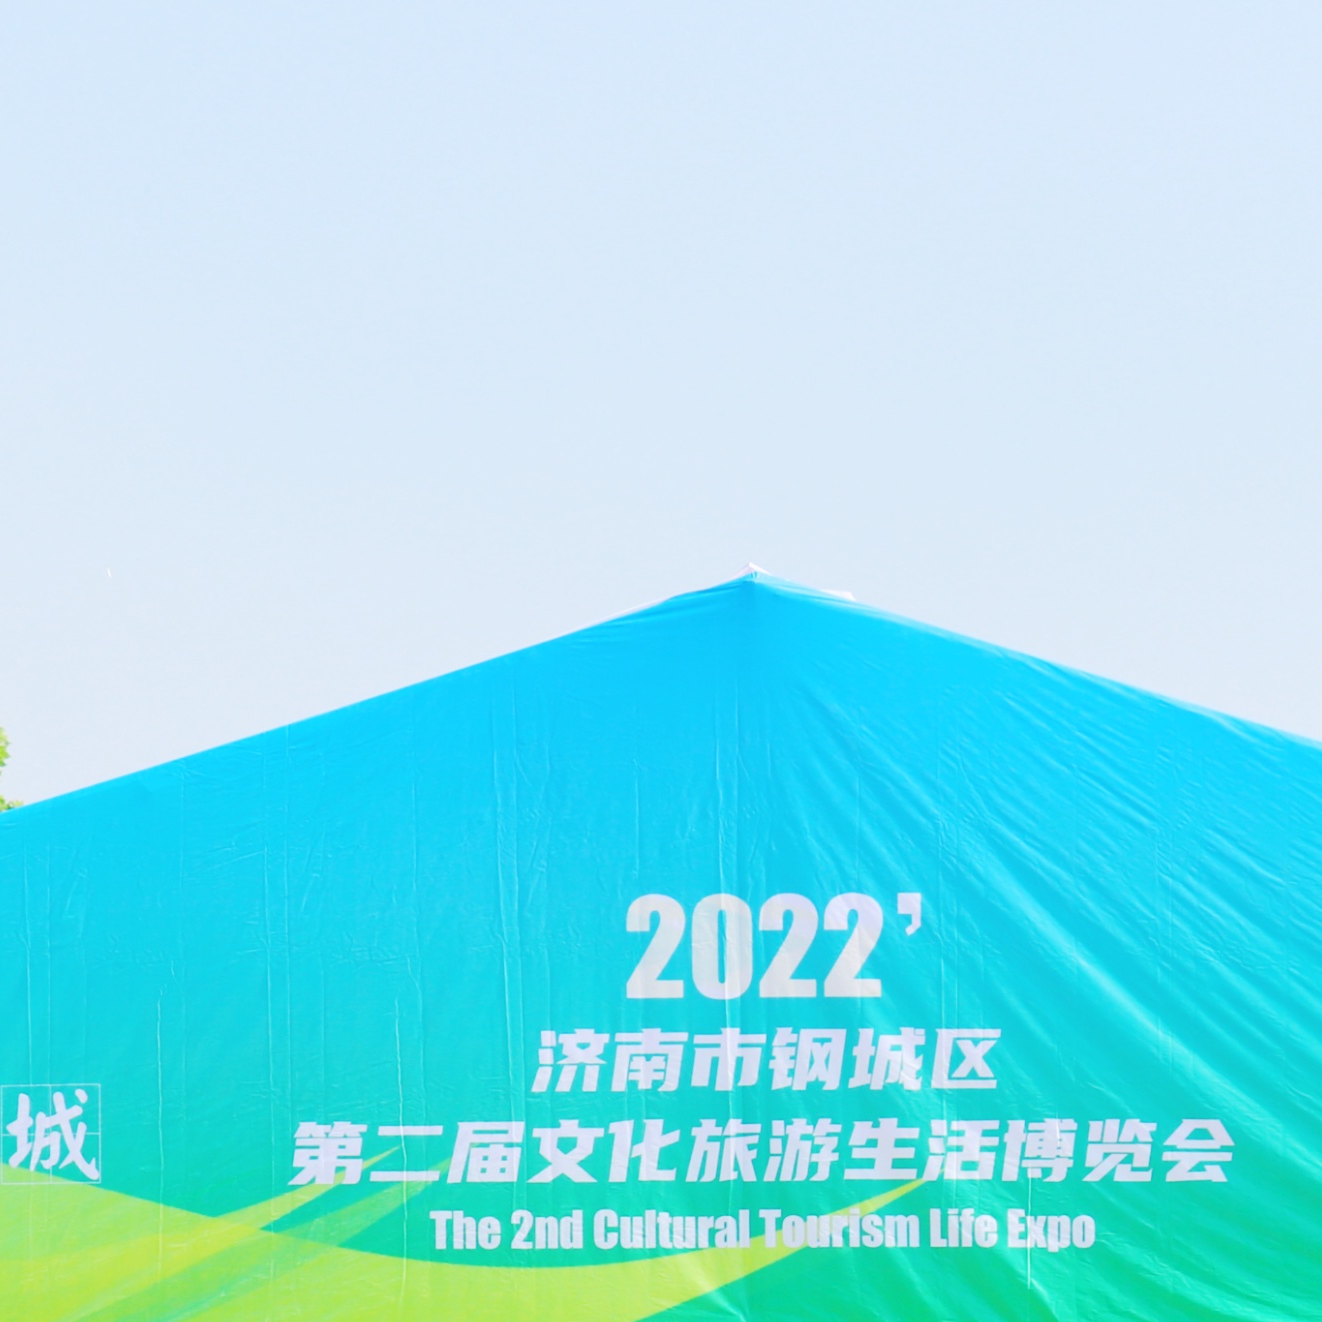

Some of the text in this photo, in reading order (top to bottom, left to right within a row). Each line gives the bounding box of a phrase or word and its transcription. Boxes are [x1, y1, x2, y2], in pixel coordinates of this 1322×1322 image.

[530, 1027, 1001, 1094] 济南市钢城区
[288, 1117, 1236, 1187] 第二届文化旅游生活博览会
[430, 1210, 1096, 1254] The 2nd Cultural Tourism Life Expo
